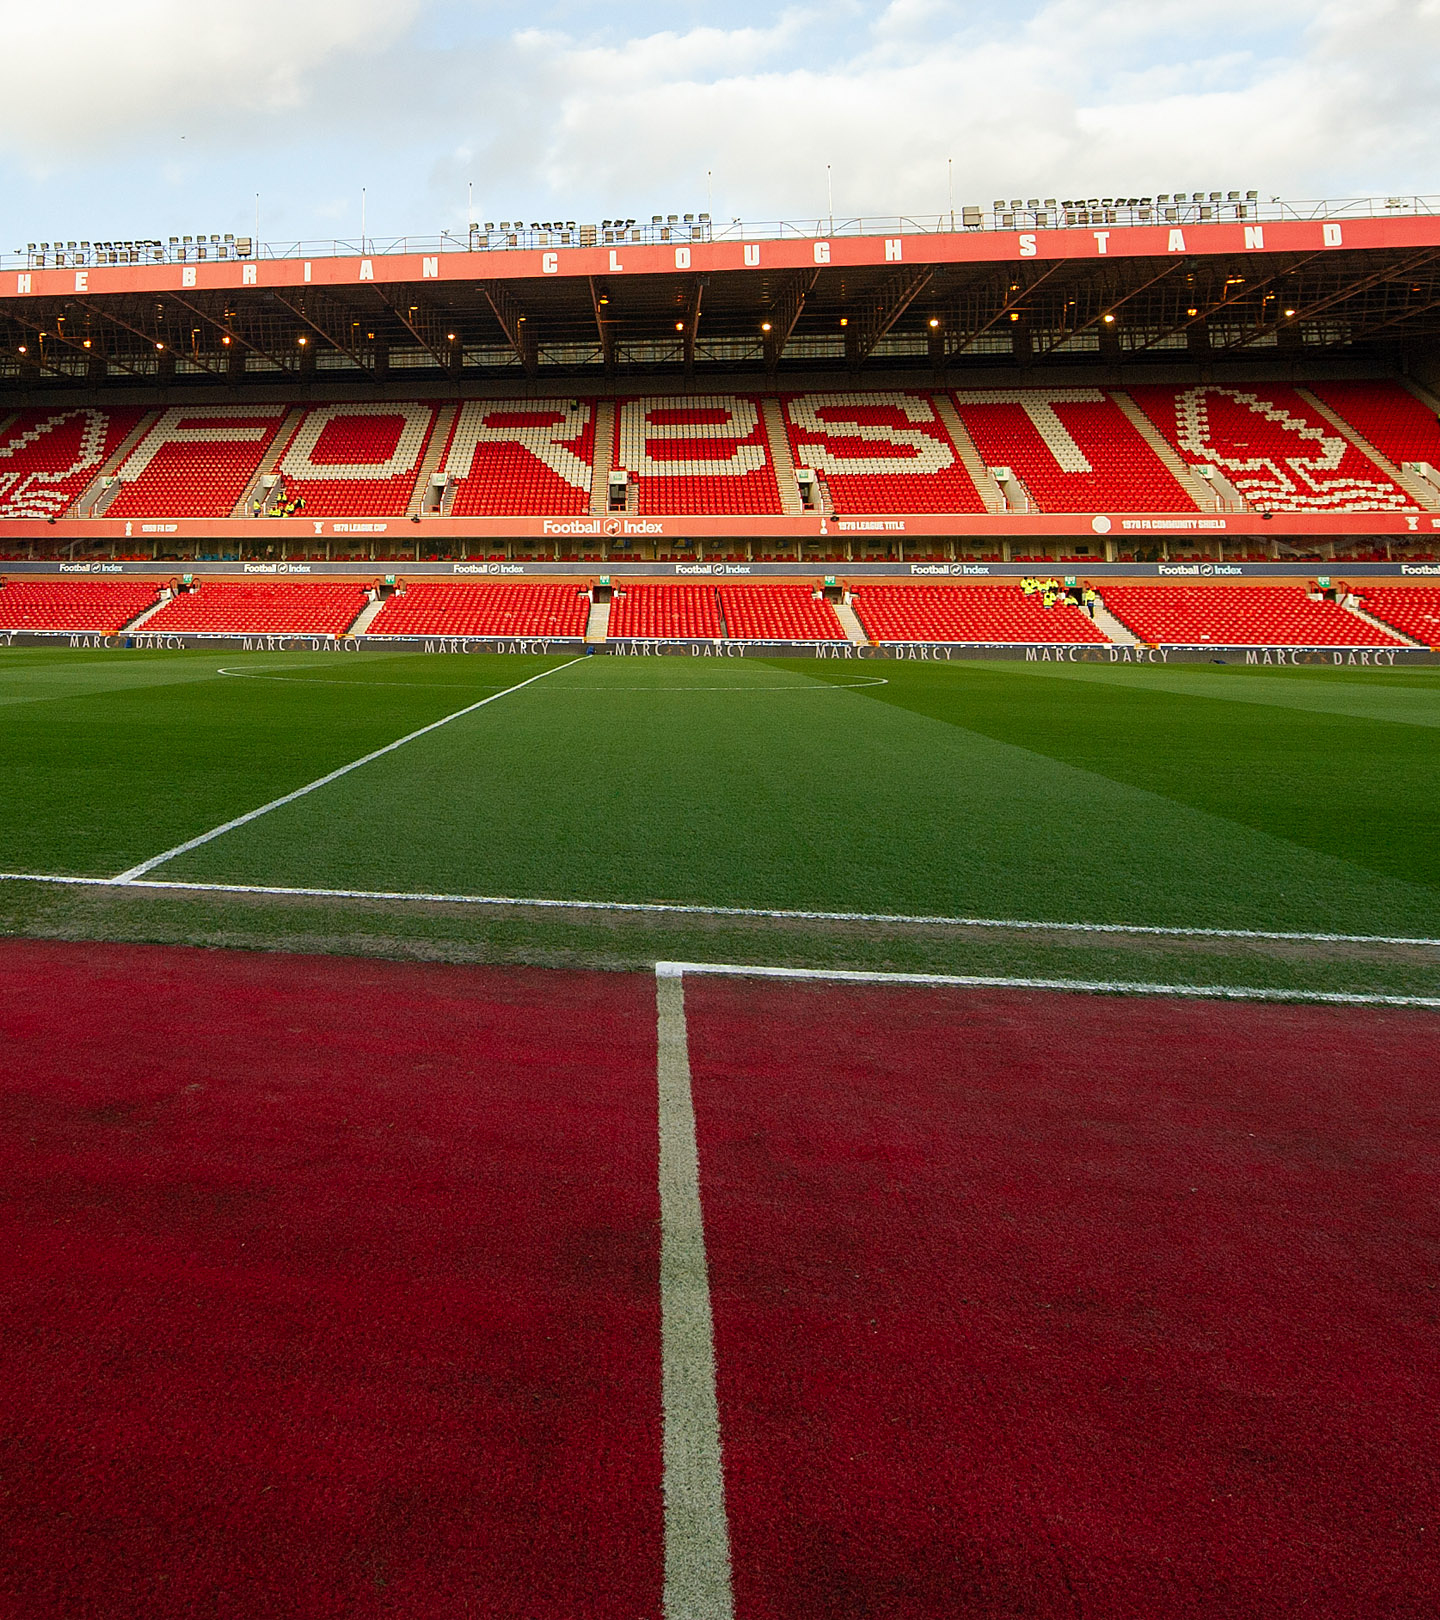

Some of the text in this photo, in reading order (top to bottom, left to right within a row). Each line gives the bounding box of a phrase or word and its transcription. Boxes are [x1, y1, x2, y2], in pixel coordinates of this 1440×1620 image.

[182, 256, 438, 287] BRIAN
[542, 239, 902, 274] CLOUGH
[1019, 223, 1343, 256] STAND
[543, 519, 663, 534] Football Index
[856, 521, 884, 530] LEAGUE
[884, 521, 905, 530] TITLE
[1141, 519, 1152, 529] FA
[1152, 519, 1197, 529] COMMUNITY
[1197, 519, 1227, 529] SHIELD
[59, 563, 123, 573] Football Index
[244, 563, 311, 574] Football Index
[453, 564, 525, 575] Football Index
[675, 564, 751, 575] Football Index
[910, 564, 990, 575] Football Index
[1158, 564, 1243, 576] Football Index
[69, 634, 111, 649] MARC
[135, 636, 184, 650] DARCY
[242, 638, 286, 651] MARC
[312, 639, 362, 652] DARCY
[424, 639, 550, 656] MARC DARCY
[614, 643, 746, 658] MARC DARCY
[815, 645, 865, 660] MARC
[895, 646, 953, 660] DARCY
[1025, 648, 1078, 662] MARC
[1109, 649, 1169, 663] DARCY
[1245, 650, 1397, 666] MARC DARCY
